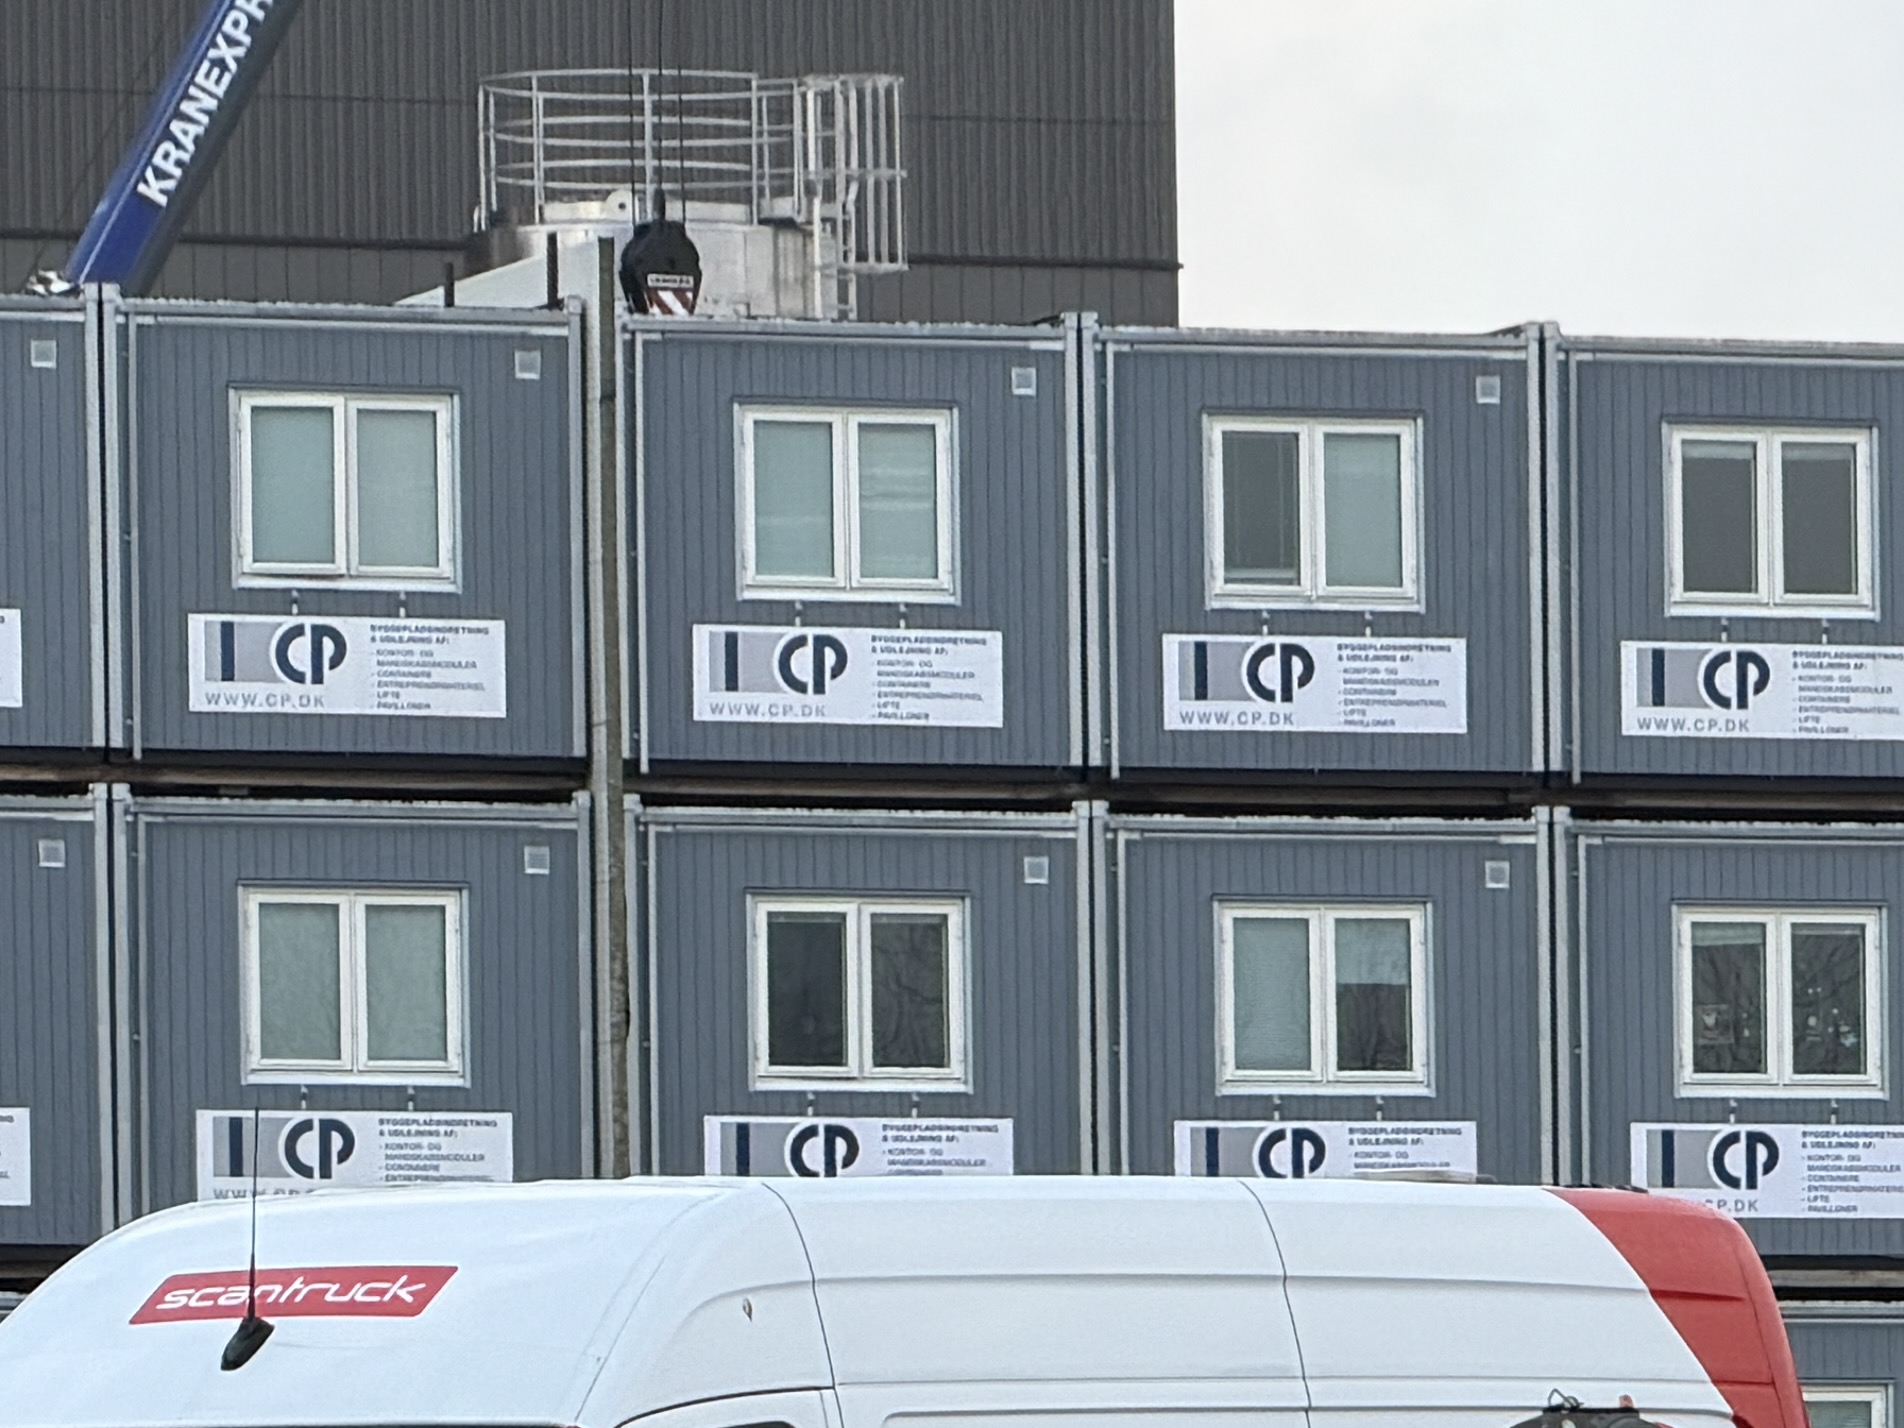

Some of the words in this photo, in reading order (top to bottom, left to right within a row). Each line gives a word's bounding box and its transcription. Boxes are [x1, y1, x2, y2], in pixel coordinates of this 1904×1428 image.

[205, 692, 324, 708] WWW.CP.DK
[710, 702, 826, 717] WWW.CP.DK
[1180, 711, 1294, 725] WWW.CP.DK
[1637, 717, 1749, 732] WWW.CP.DK
[156, 1274, 426, 1310] scantruck
